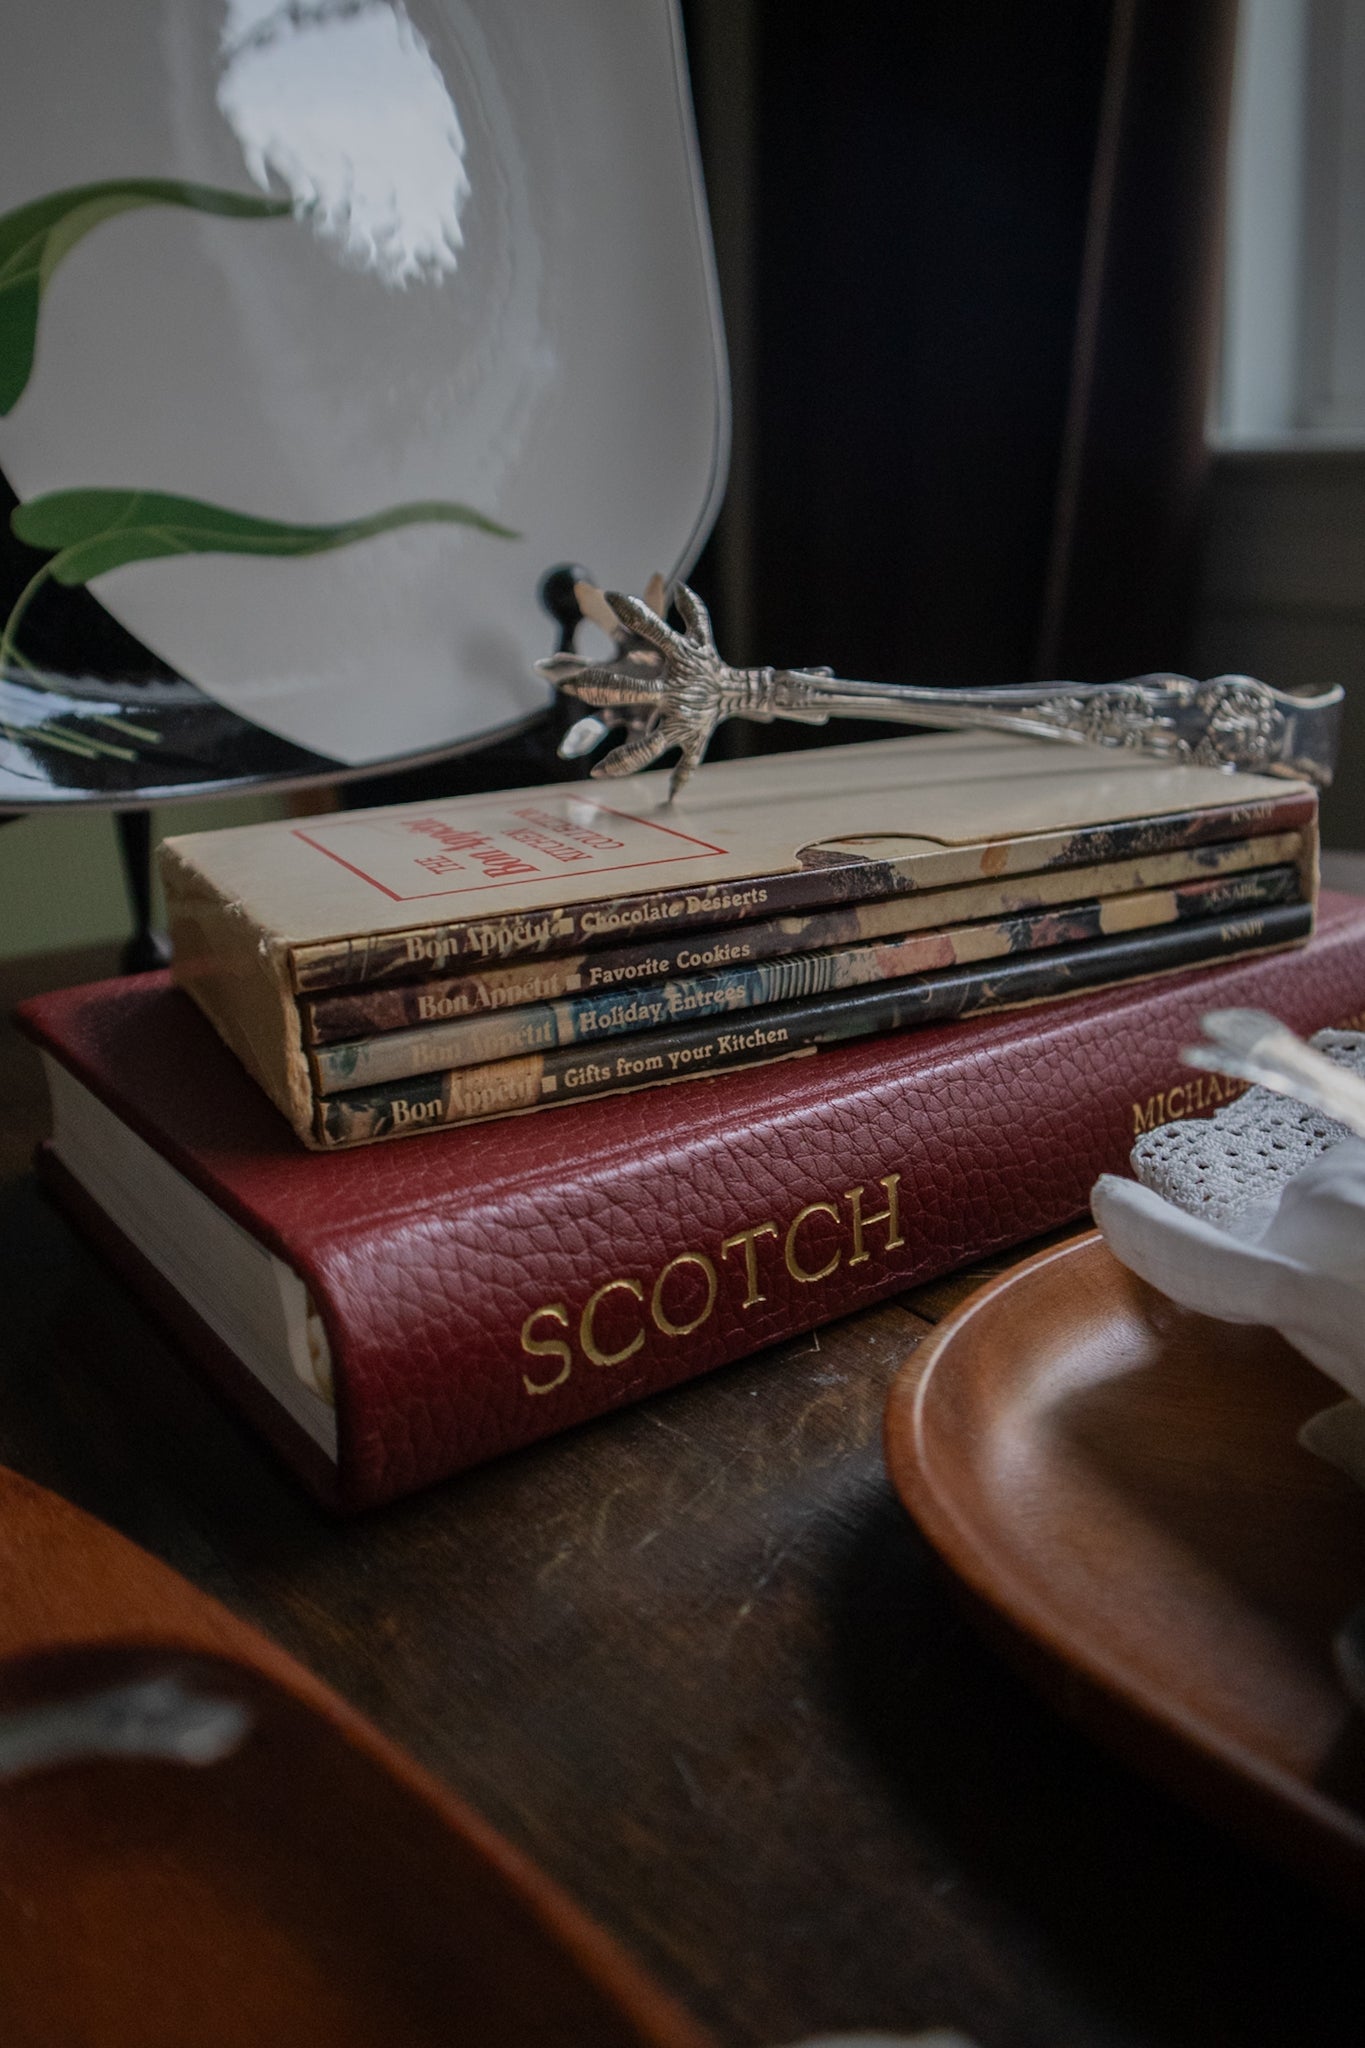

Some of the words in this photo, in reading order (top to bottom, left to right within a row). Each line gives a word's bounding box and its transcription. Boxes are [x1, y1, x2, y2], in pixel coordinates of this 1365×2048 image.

[414, 855, 467, 875] THE
[469, 848, 541, 878] Bon
[501, 828, 593, 863] KITCHEN
[405, 935, 458, 962] Bon
[581, 900, 679, 932] Chocolate
[687, 887, 768, 915] Desserts
[418, 990, 469, 1019] Bon
[473, 974, 560, 1010] Appétit
[589, 957, 669, 986] Favorite
[677, 943, 750, 969] Cookies
[579, 1001, 668, 1033] Holiday
[390, 1097, 442, 1124] Bon
[564, 1063, 610, 1088] Gifts
[616, 1055, 663, 1078] from
[668, 1045, 714, 1070] your
[717, 1027, 788, 1054] Kitchen
[520, 1173, 905, 1396] SCOTCH
